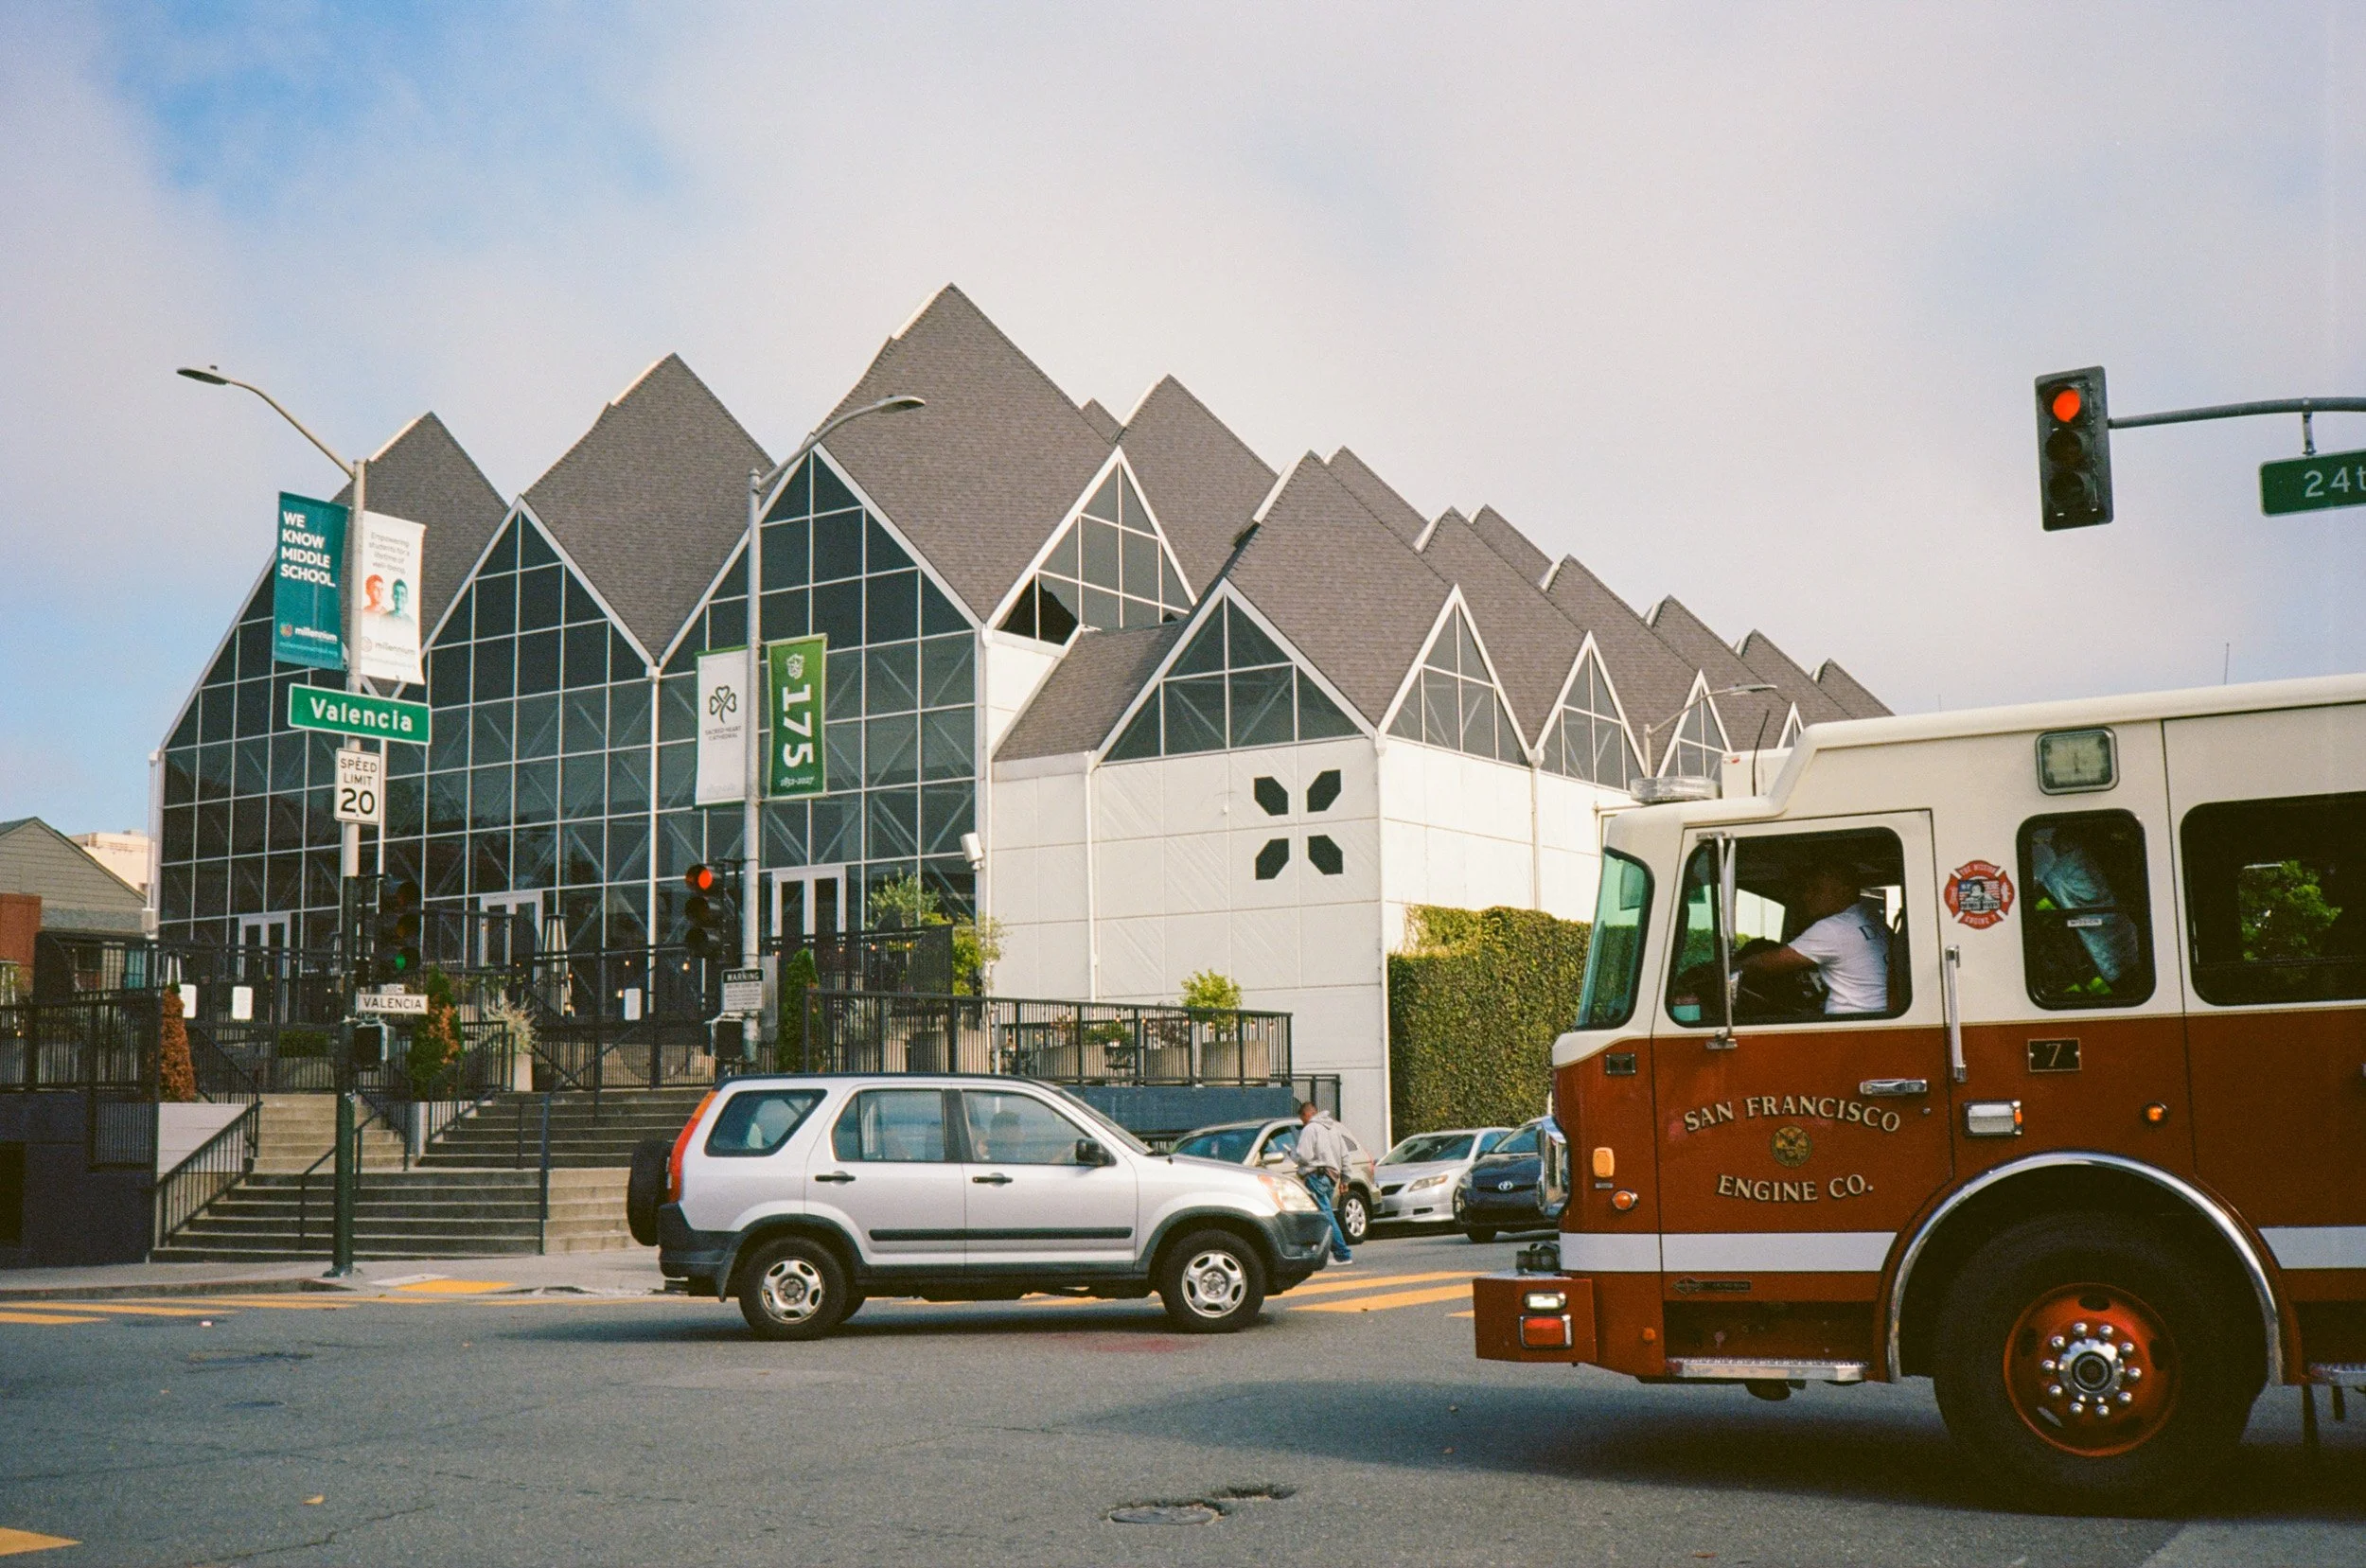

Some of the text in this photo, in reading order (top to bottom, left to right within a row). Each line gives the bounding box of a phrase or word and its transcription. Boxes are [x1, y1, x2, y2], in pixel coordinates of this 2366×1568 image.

[283, 511, 306, 528] WE
[282, 529, 326, 549] KNOW
[371, 532, 410, 548] Empowering
[369, 541, 395, 555] students
[281, 546, 331, 569] MIDDLE
[280, 564, 336, 588] SCHOOL.
[294, 626, 338, 643] millennium
[375, 641, 416, 655] millennium
[310, 696, 414, 732] Valencia
[704, 727, 725, 735] SACRED
[782, 684, 814, 767] 175
[708, 732, 738, 741] CATHEDRAL
[340, 758, 378, 773] SPEED
[344, 773, 373, 785] LIMIT
[340, 787, 376, 815] 20
[727, 972, 760, 981] WARNING
[363, 997, 423, 1010] VALENCIA
[2045, 1043, 2061, 1067] 7
[1684, 1095, 1901, 1134] SAN FRANCISCO
[1718, 1173, 1875, 1203] ENGINE CO.
